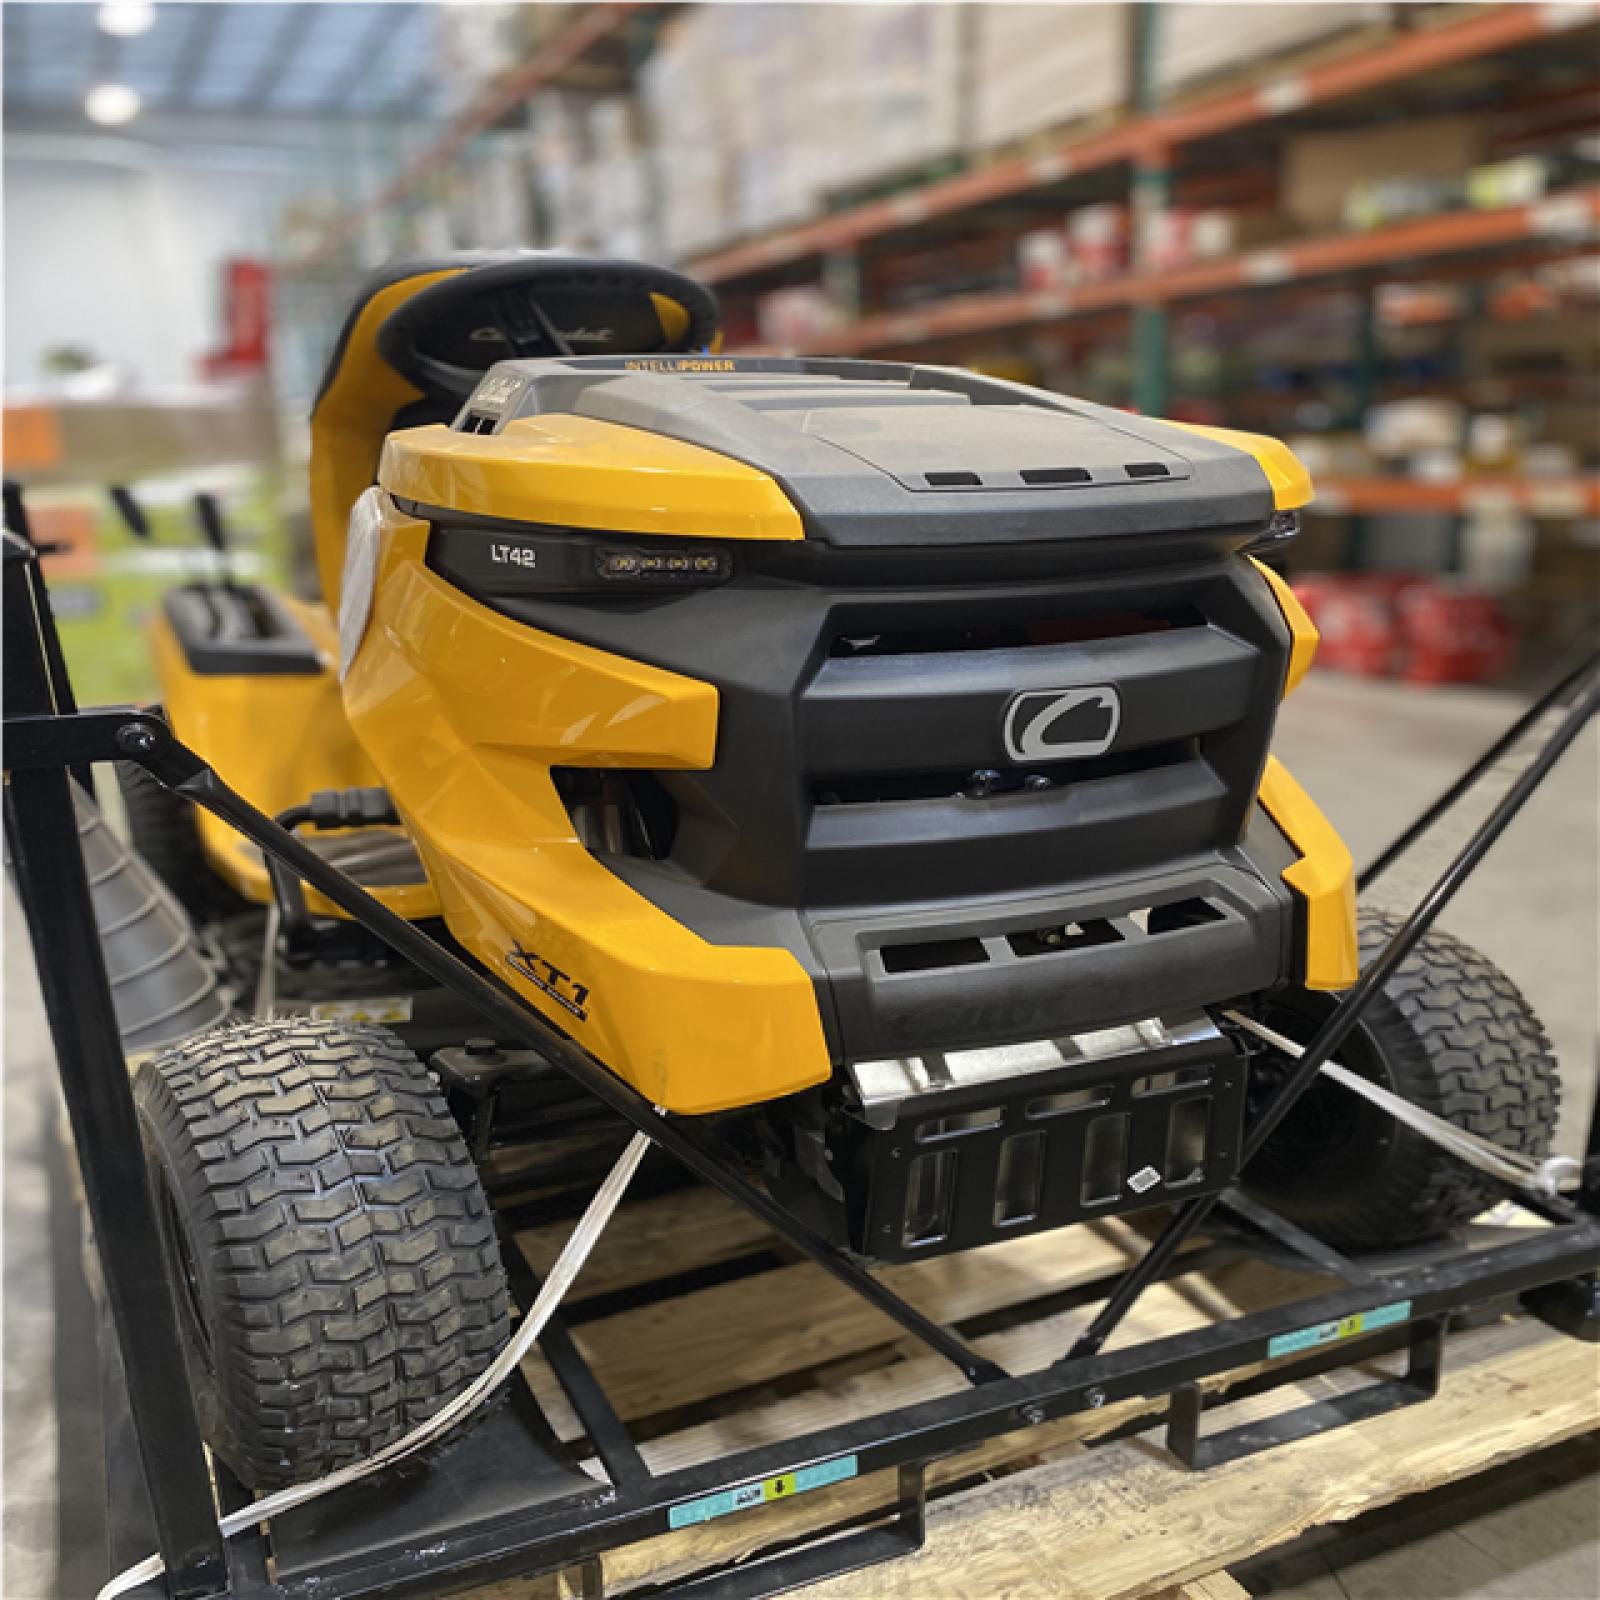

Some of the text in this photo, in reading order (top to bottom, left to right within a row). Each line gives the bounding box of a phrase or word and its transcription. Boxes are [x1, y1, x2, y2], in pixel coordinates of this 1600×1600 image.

[624, 358, 736, 373] INTELLIPOWER
[489, 544, 536, 569] LT42
[508, 939, 589, 1006] XT1
